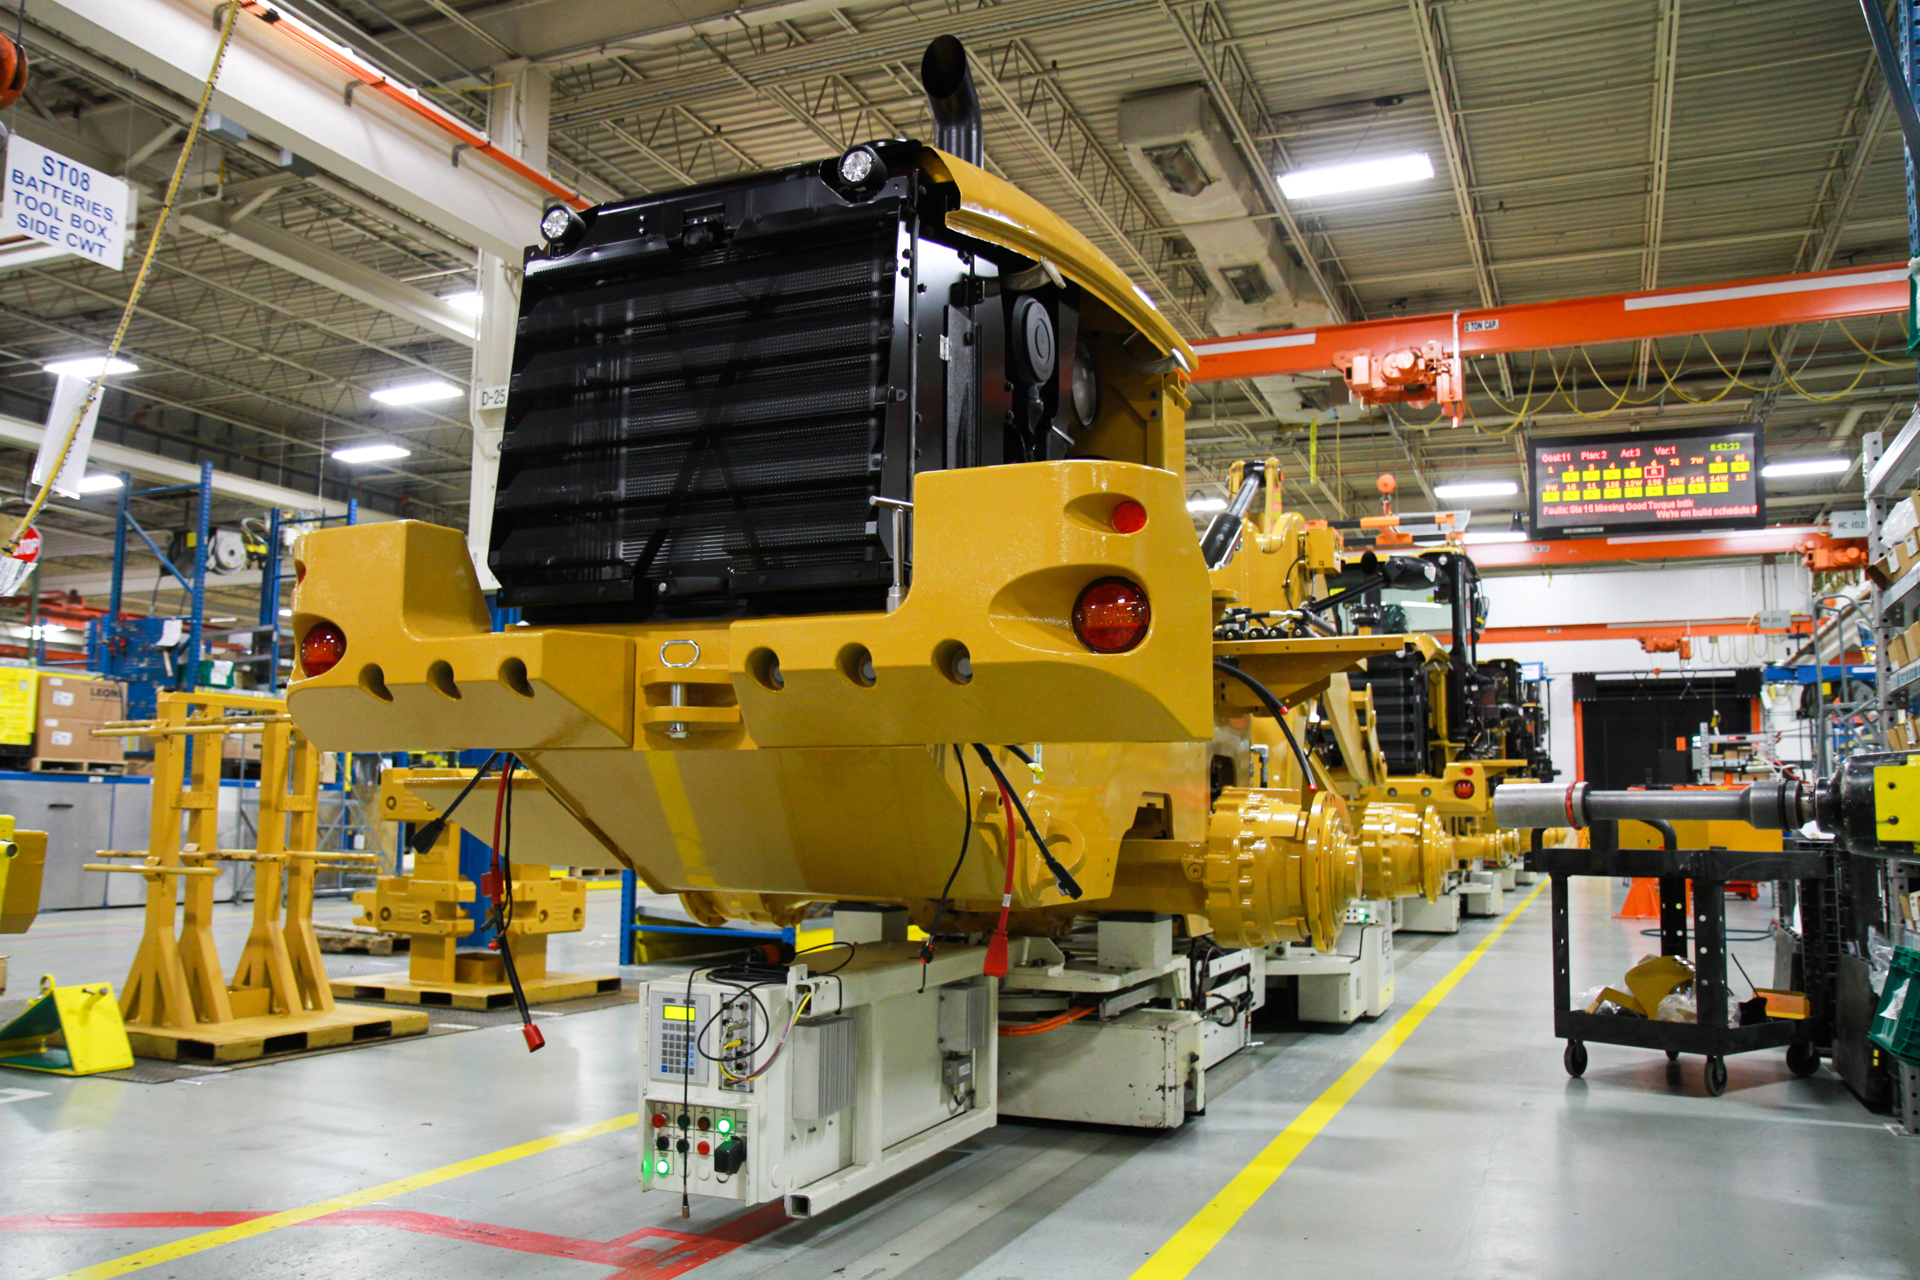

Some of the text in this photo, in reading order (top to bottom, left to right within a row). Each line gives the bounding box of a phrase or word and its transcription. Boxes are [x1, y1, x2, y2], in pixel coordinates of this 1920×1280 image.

[42, 155, 90, 191] ST08
[12, 168, 118, 226] BATTERIES,
[13, 189, 112, 243] TOOL BOX,
[17, 213, 106, 257] SIDE CWT
[1465, 323, 1469, 331] 2
[1471, 321, 1483, 331] TON
[482, 389, 505, 406] D-25
[1568, 464, 1575, 472] 2
[1595, 503, 1624, 513] Missing
[1625, 501, 1646, 511] Good
[1648, 500, 1675, 510] Torque
[1681, 508, 1691, 517] on
[1692, 506, 1712, 516] build
[1713, 505, 1750, 515] schedule
